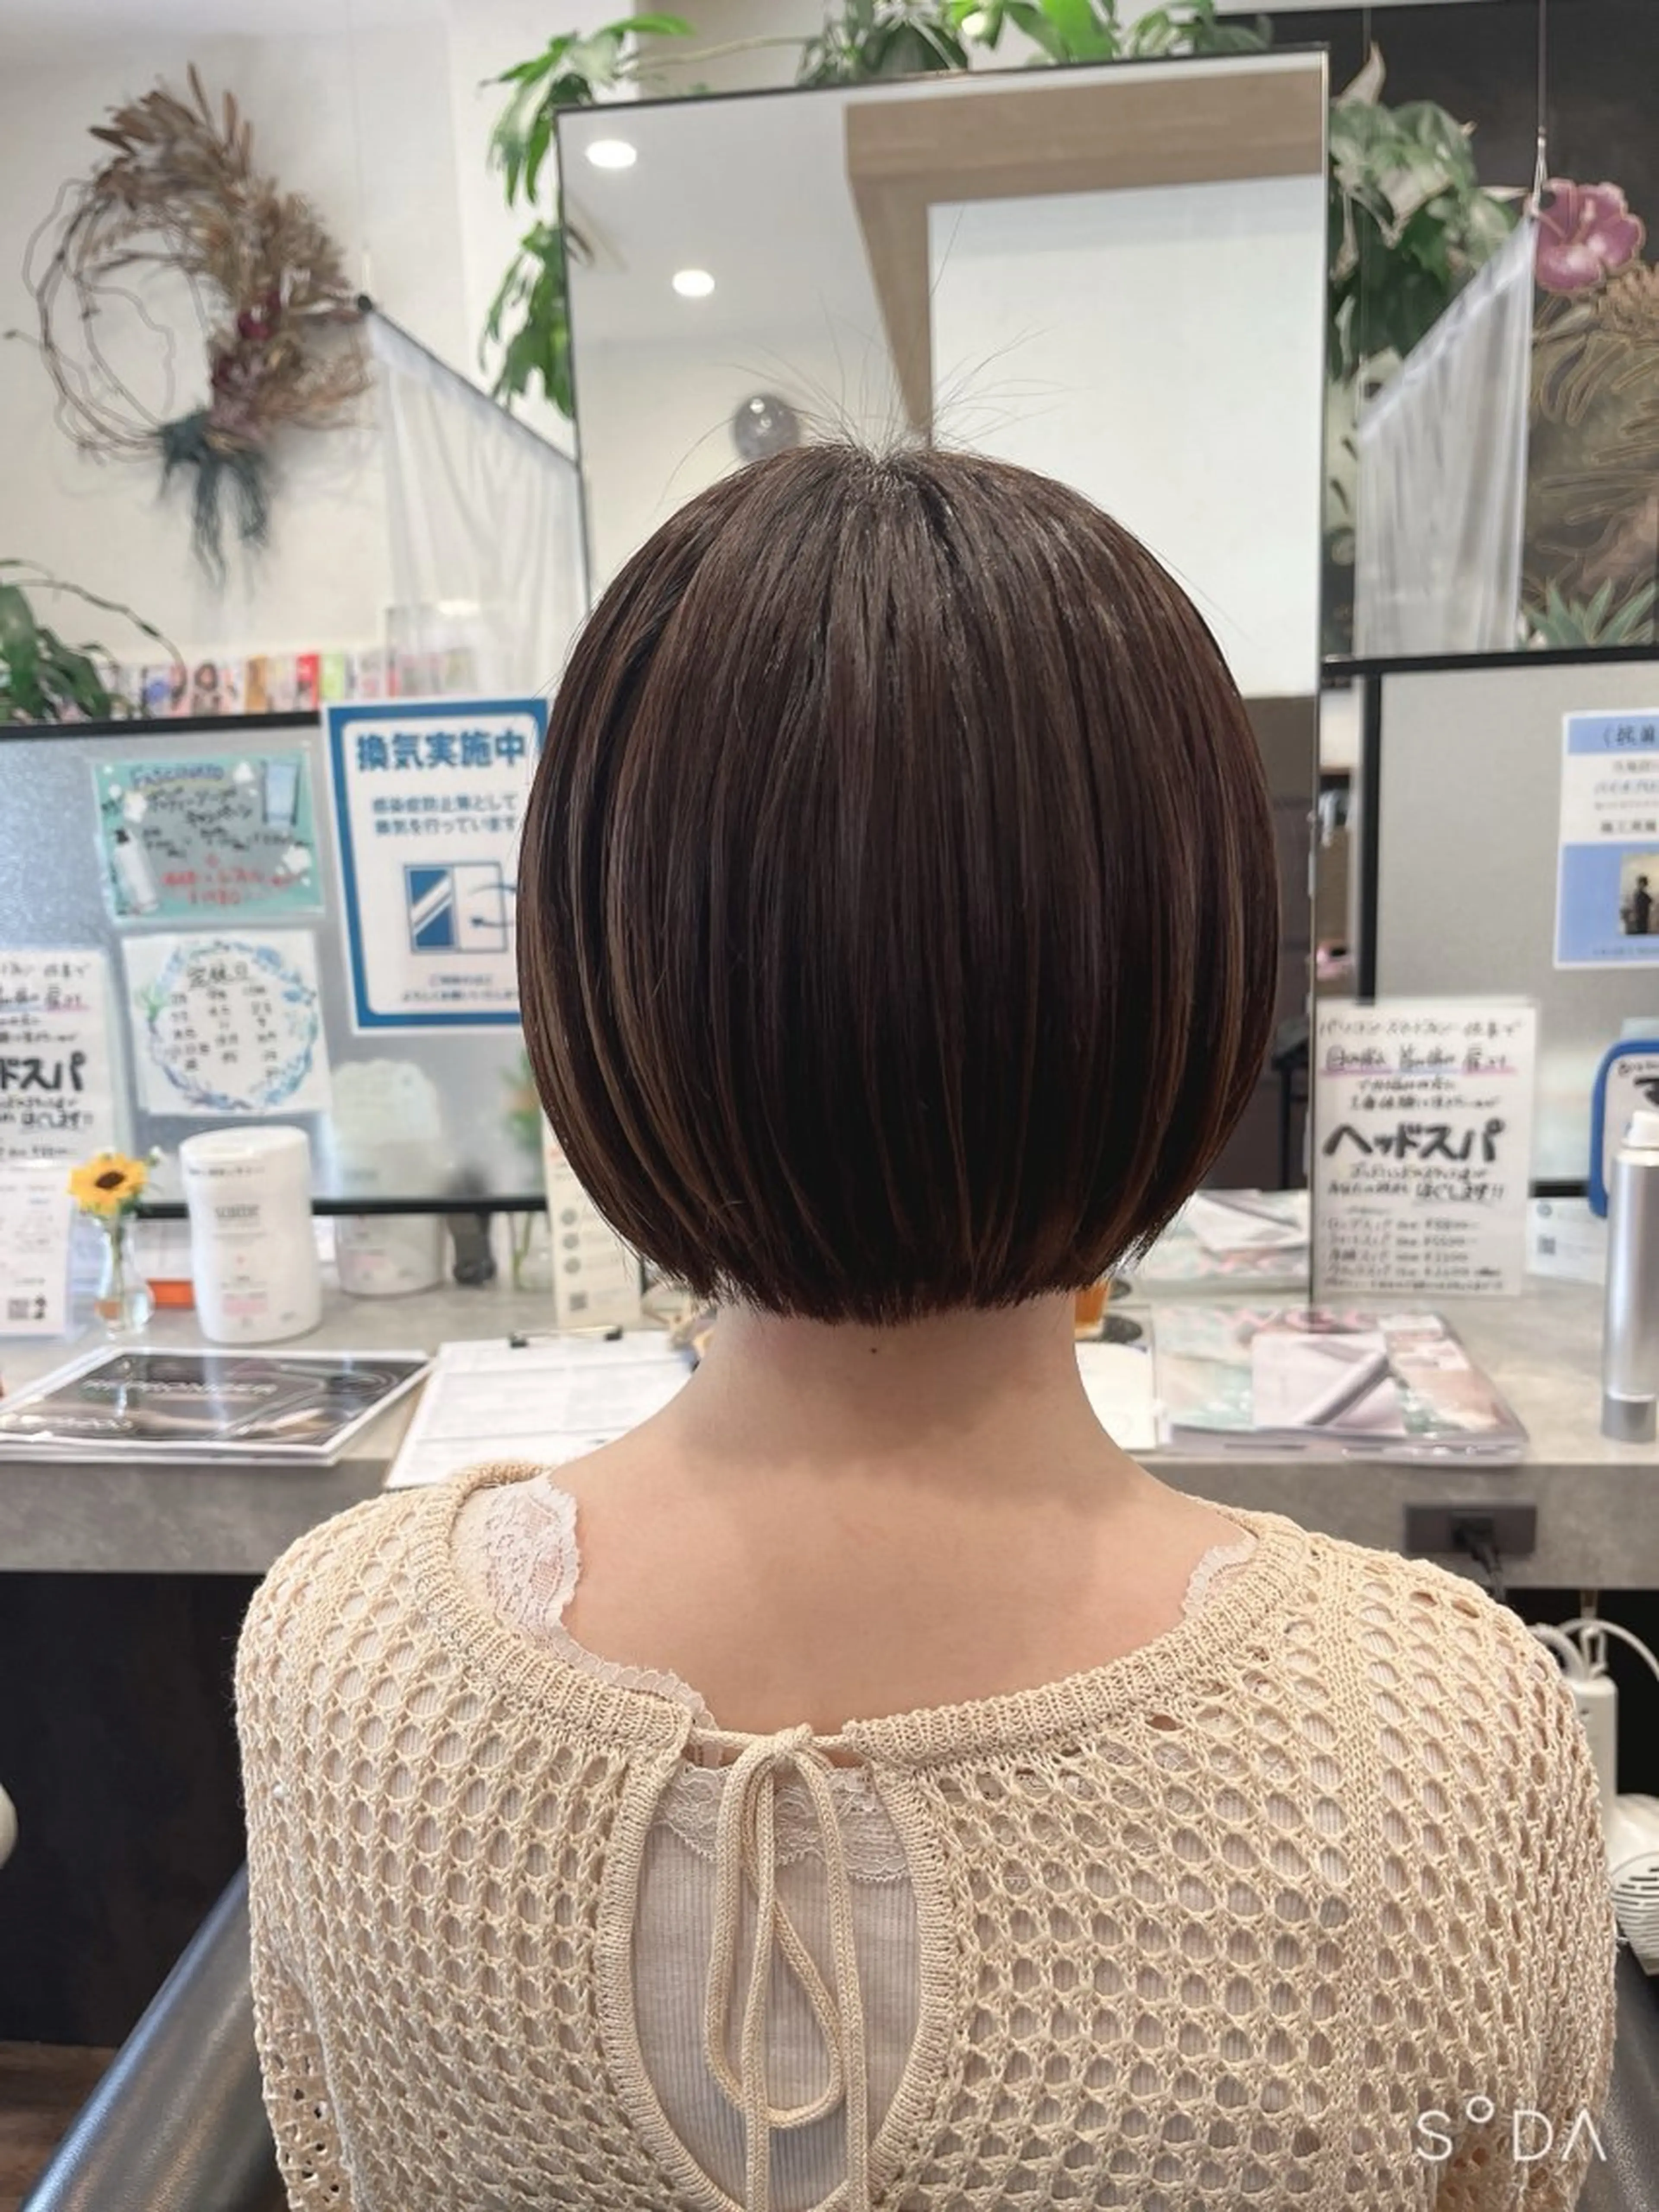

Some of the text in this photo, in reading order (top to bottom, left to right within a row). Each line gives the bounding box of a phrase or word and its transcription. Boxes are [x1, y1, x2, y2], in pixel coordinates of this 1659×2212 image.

[358, 728, 526, 772] 換気実施中
[1322, 1117, 1506, 1163] ヘッドスパ
